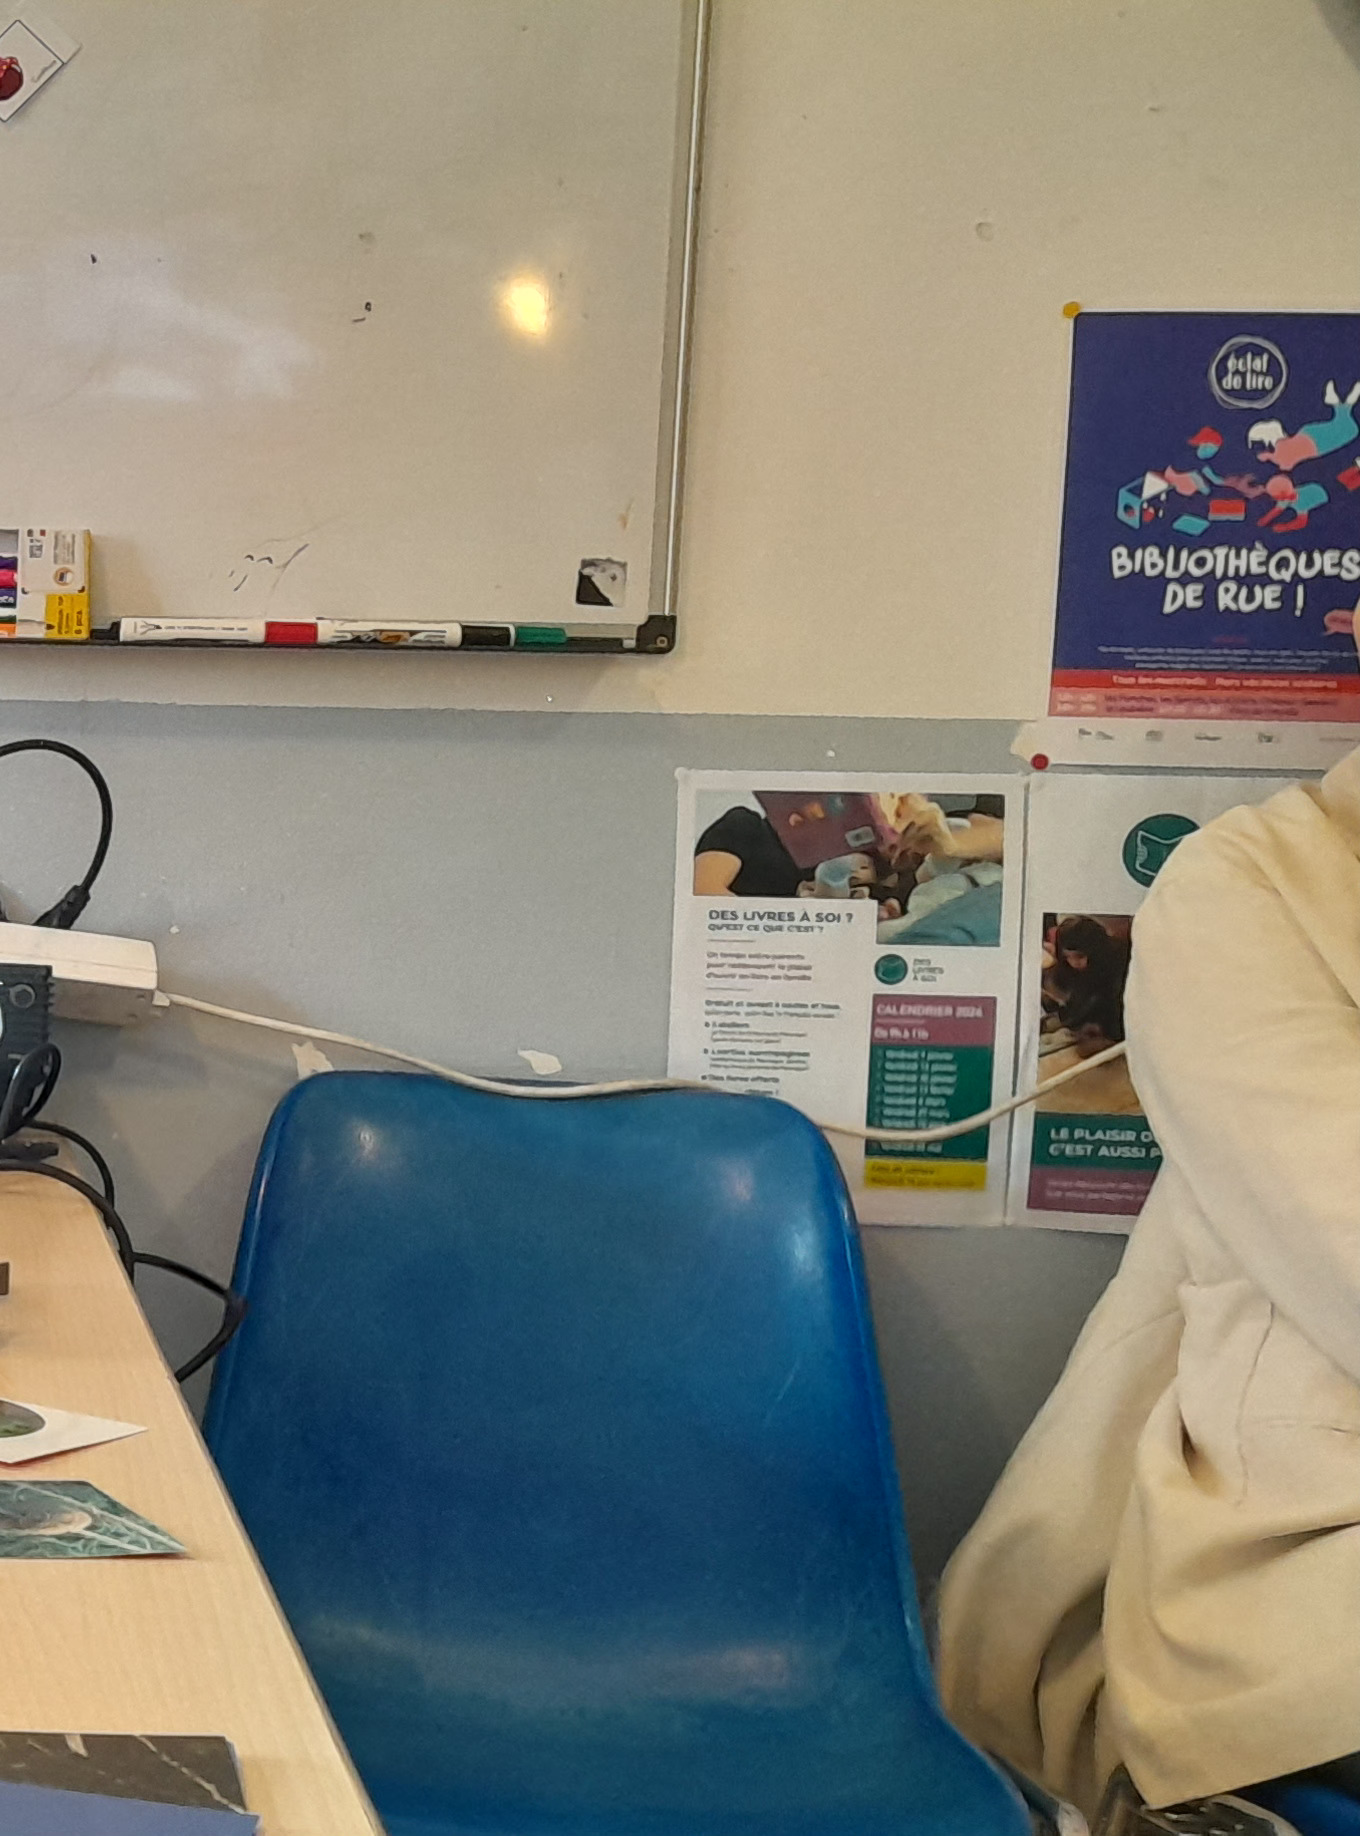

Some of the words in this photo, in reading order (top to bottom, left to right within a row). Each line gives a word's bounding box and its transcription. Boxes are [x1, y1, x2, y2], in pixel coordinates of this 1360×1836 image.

[1111, 541, 1360, 583] BIBLIOTHÈQUES
[1162, 581, 1204, 614] DE
[1218, 580, 1281, 613] RUE
[1295, 582, 1304, 617] !
[709, 910, 739, 921] DES
[743, 911, 796, 922] LIVRES
[799, 908, 811, 922] À
[815, 912, 841, 923] SOI
[845, 912, 854, 923] ?
[877, 1004, 953, 1018] CALENDRIER
[1050, 1128, 1069, 1140] LE
[1074, 1129, 1136, 1142] PLAISIR
[1049, 1143, 1094, 1156] C'EST
[1098, 1145, 1146, 1158] AUSSI
